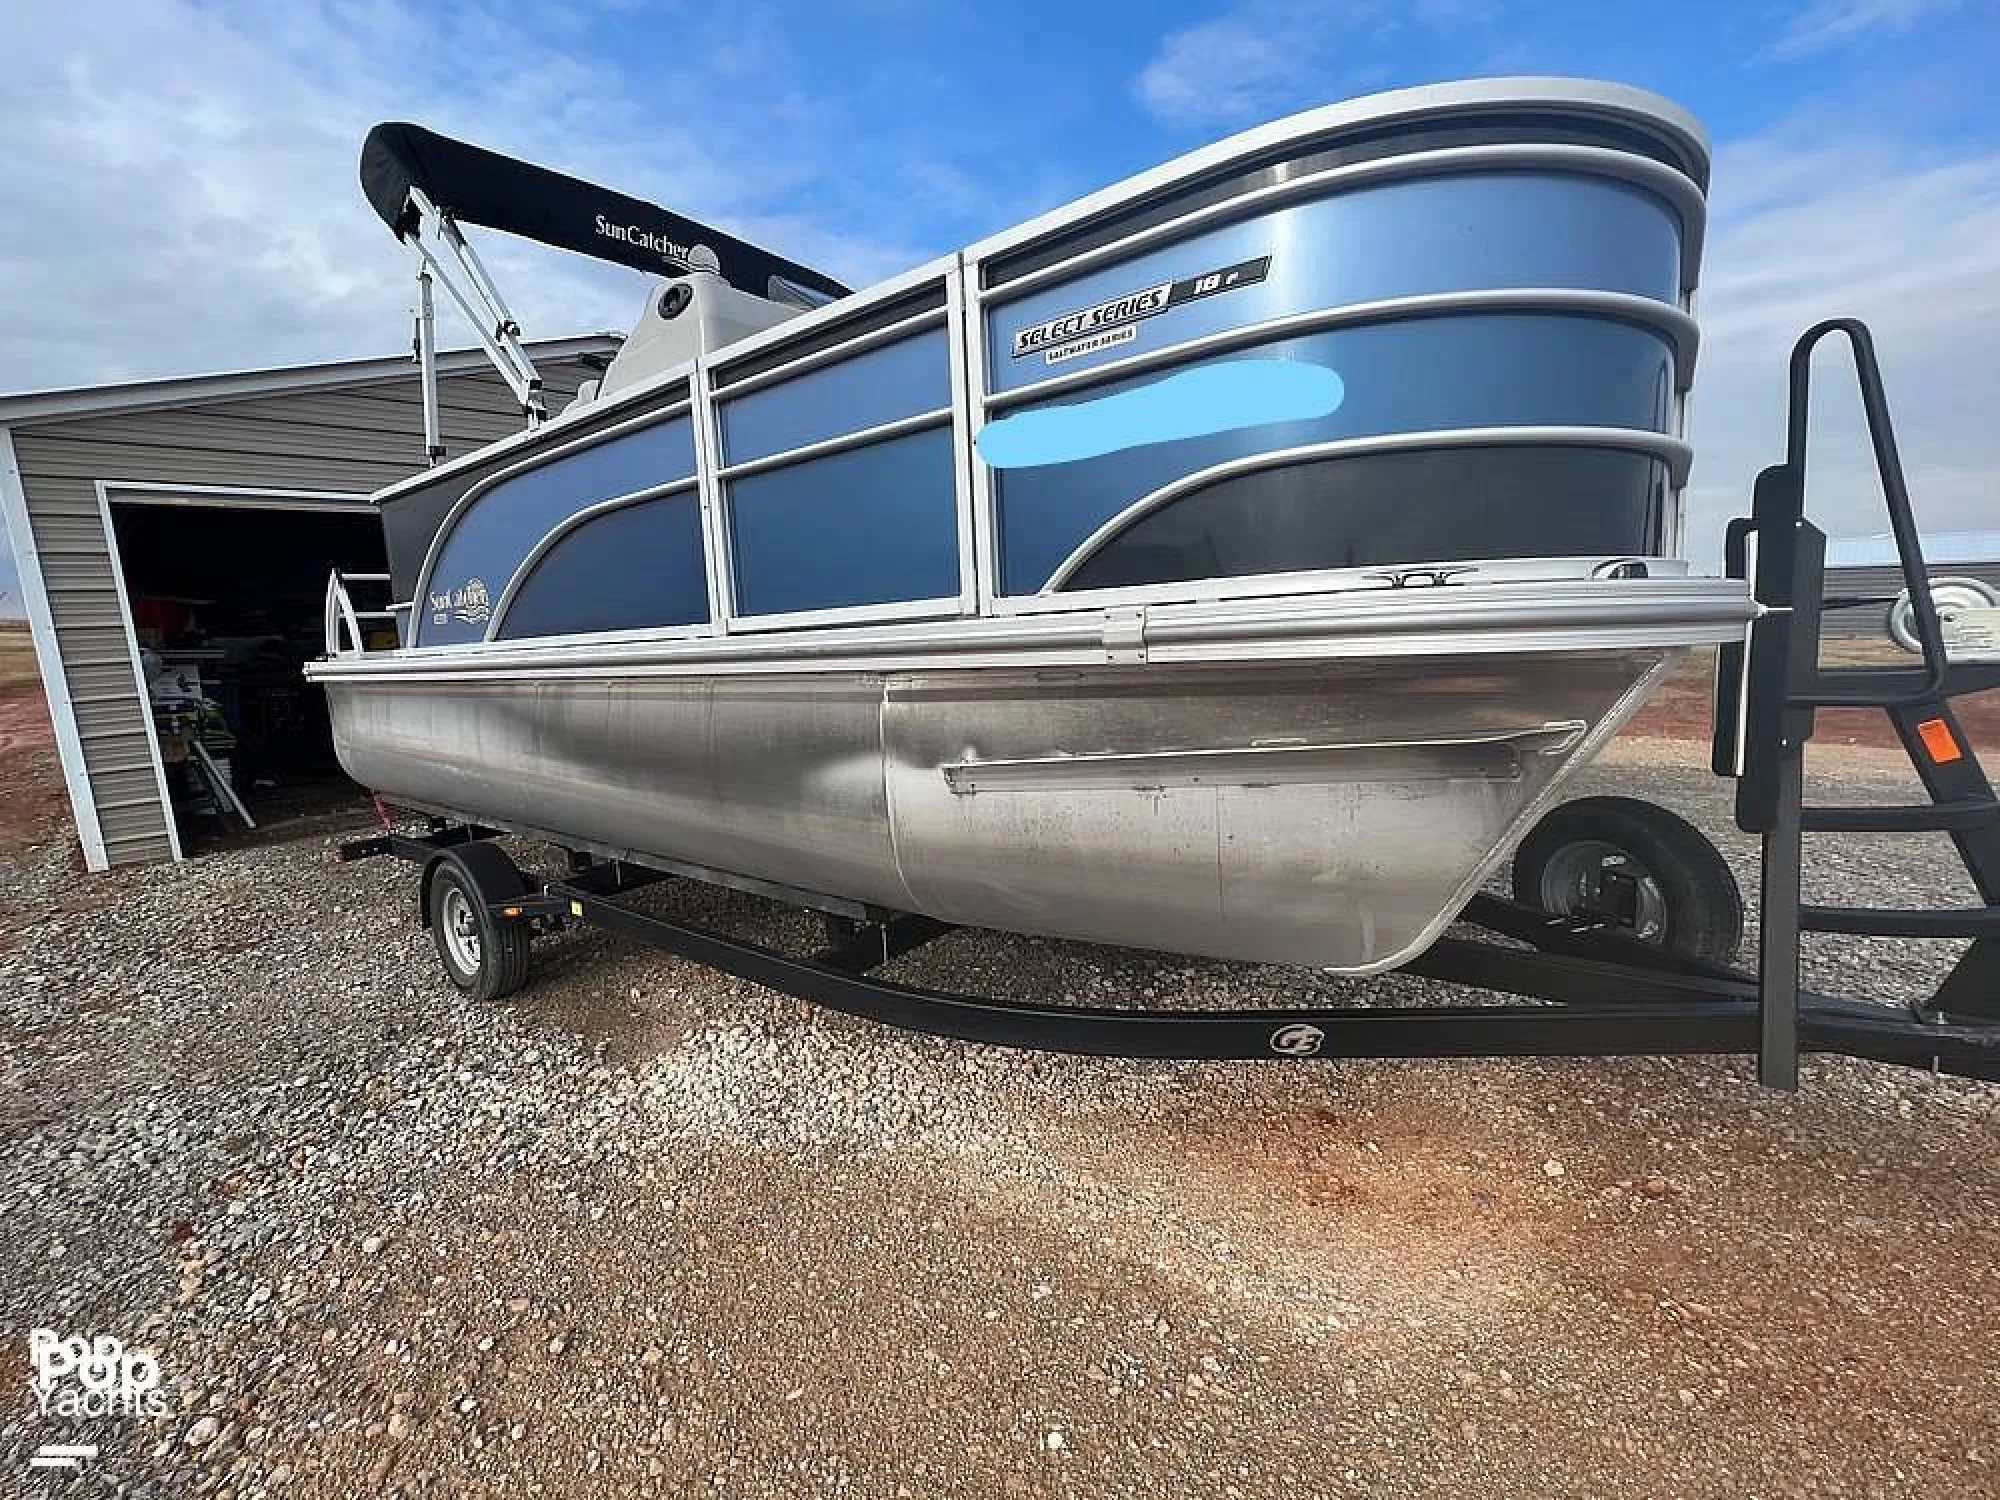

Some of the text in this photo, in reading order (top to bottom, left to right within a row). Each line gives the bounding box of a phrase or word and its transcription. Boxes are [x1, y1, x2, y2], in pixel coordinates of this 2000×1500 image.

[595, 213, 689, 259] SunCatcher
[1018, 312, 1087, 349] SELECT
[1091, 289, 1163, 325] SERIES
